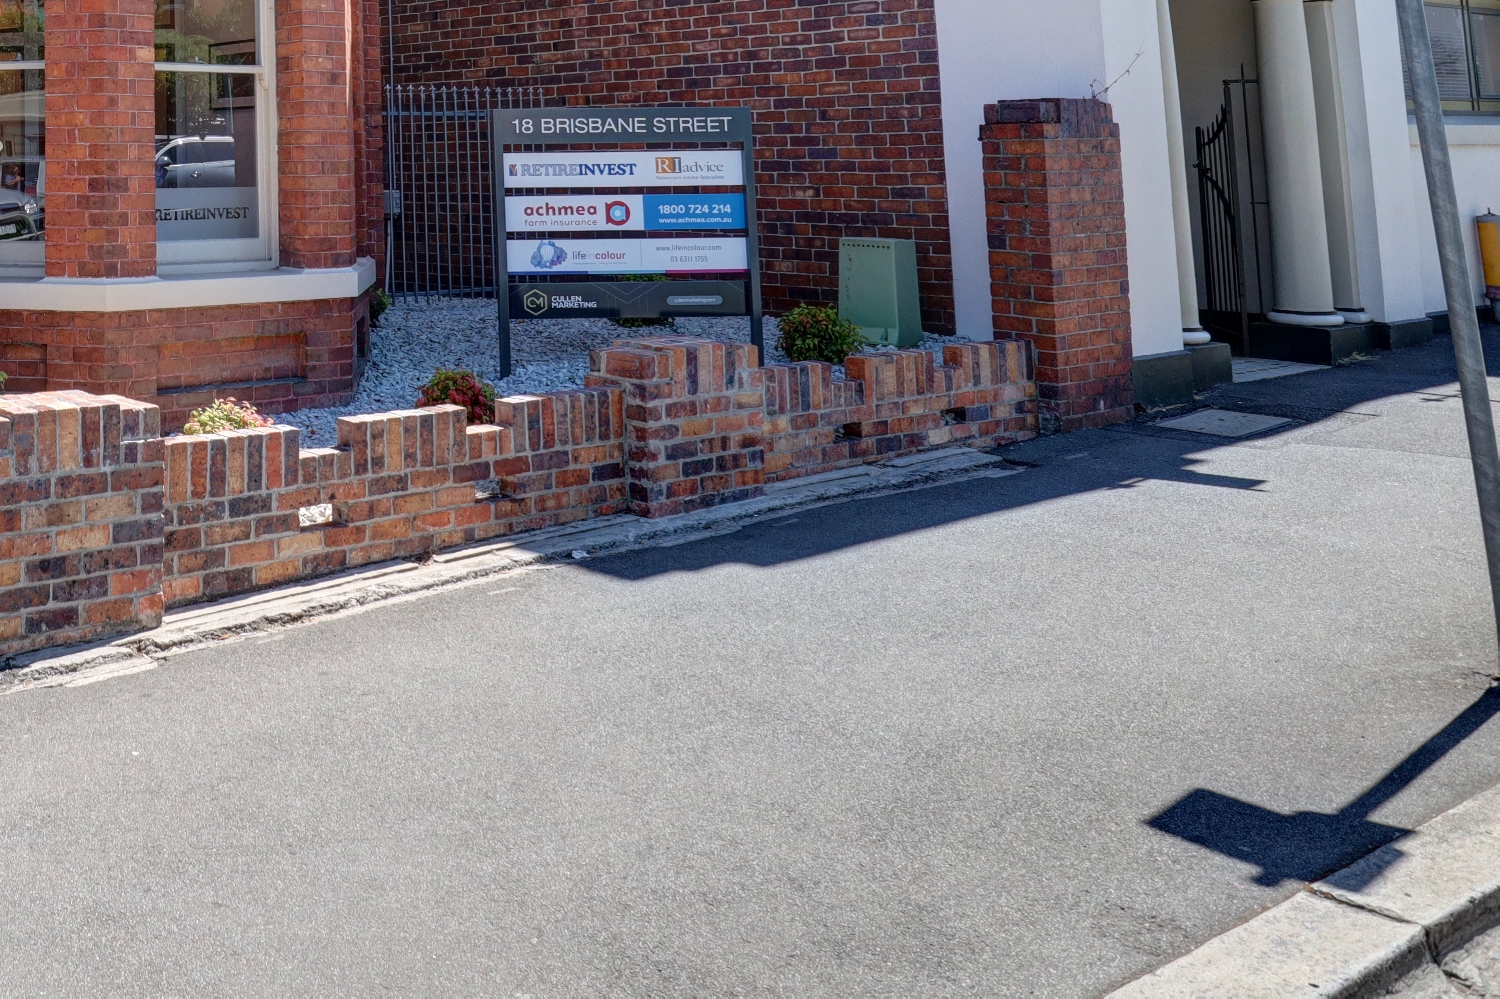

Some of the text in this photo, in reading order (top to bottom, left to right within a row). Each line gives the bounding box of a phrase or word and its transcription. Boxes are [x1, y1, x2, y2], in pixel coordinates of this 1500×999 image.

[511, 116, 733, 134] 18 BRISBANE STREET
[520, 163, 637, 177] RETIREINVEST
[155, 206, 250, 221] RETIREINVEST
[524, 202, 597, 217] achmea
[658, 204, 732, 214] 1800 724 214
[524, 218, 598, 227] farm insurance
[658, 216, 732, 224] www.achmea.com.au
[655, 244, 722, 252] www.lifeincolour.com
[572, 250, 626, 260] lifeincolour
[679, 255, 693, 263] 6311
